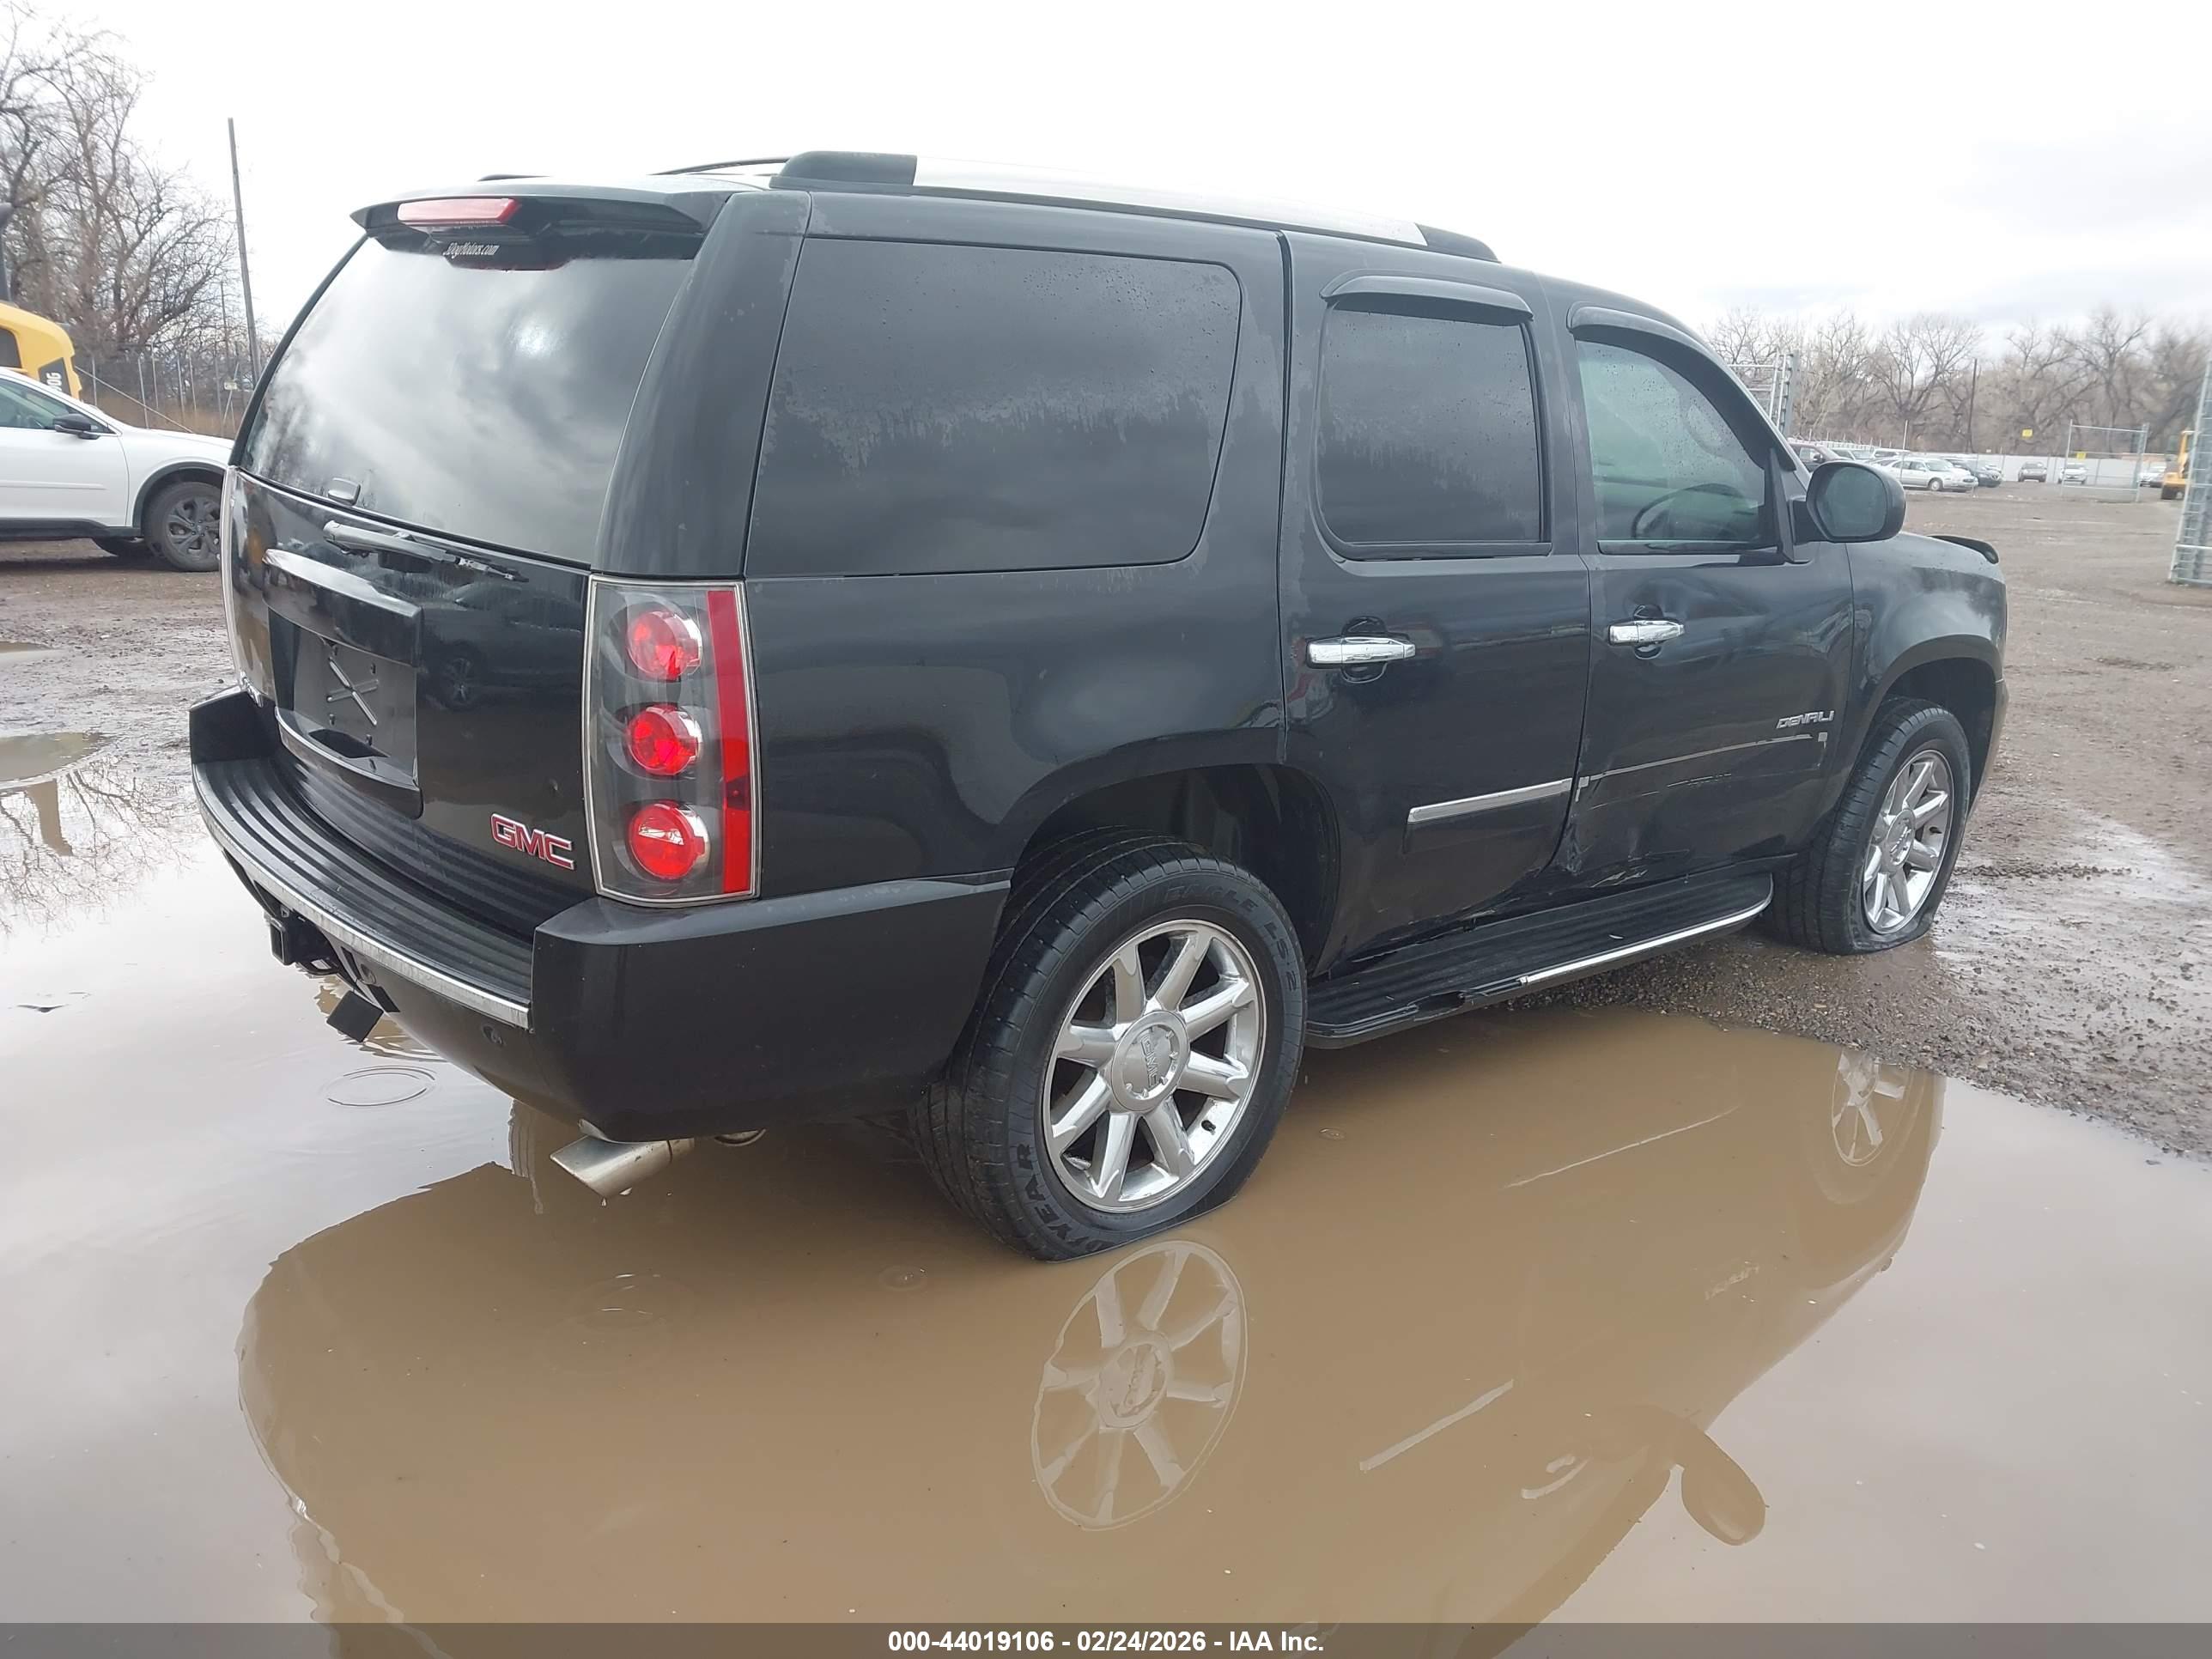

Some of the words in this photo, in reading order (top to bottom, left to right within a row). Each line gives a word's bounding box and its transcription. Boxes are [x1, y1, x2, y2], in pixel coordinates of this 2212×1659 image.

[1776, 710, 1835, 729] DENALI
[490, 813, 574, 870] GMC
[1167, 884, 1259, 913] EAGLE
